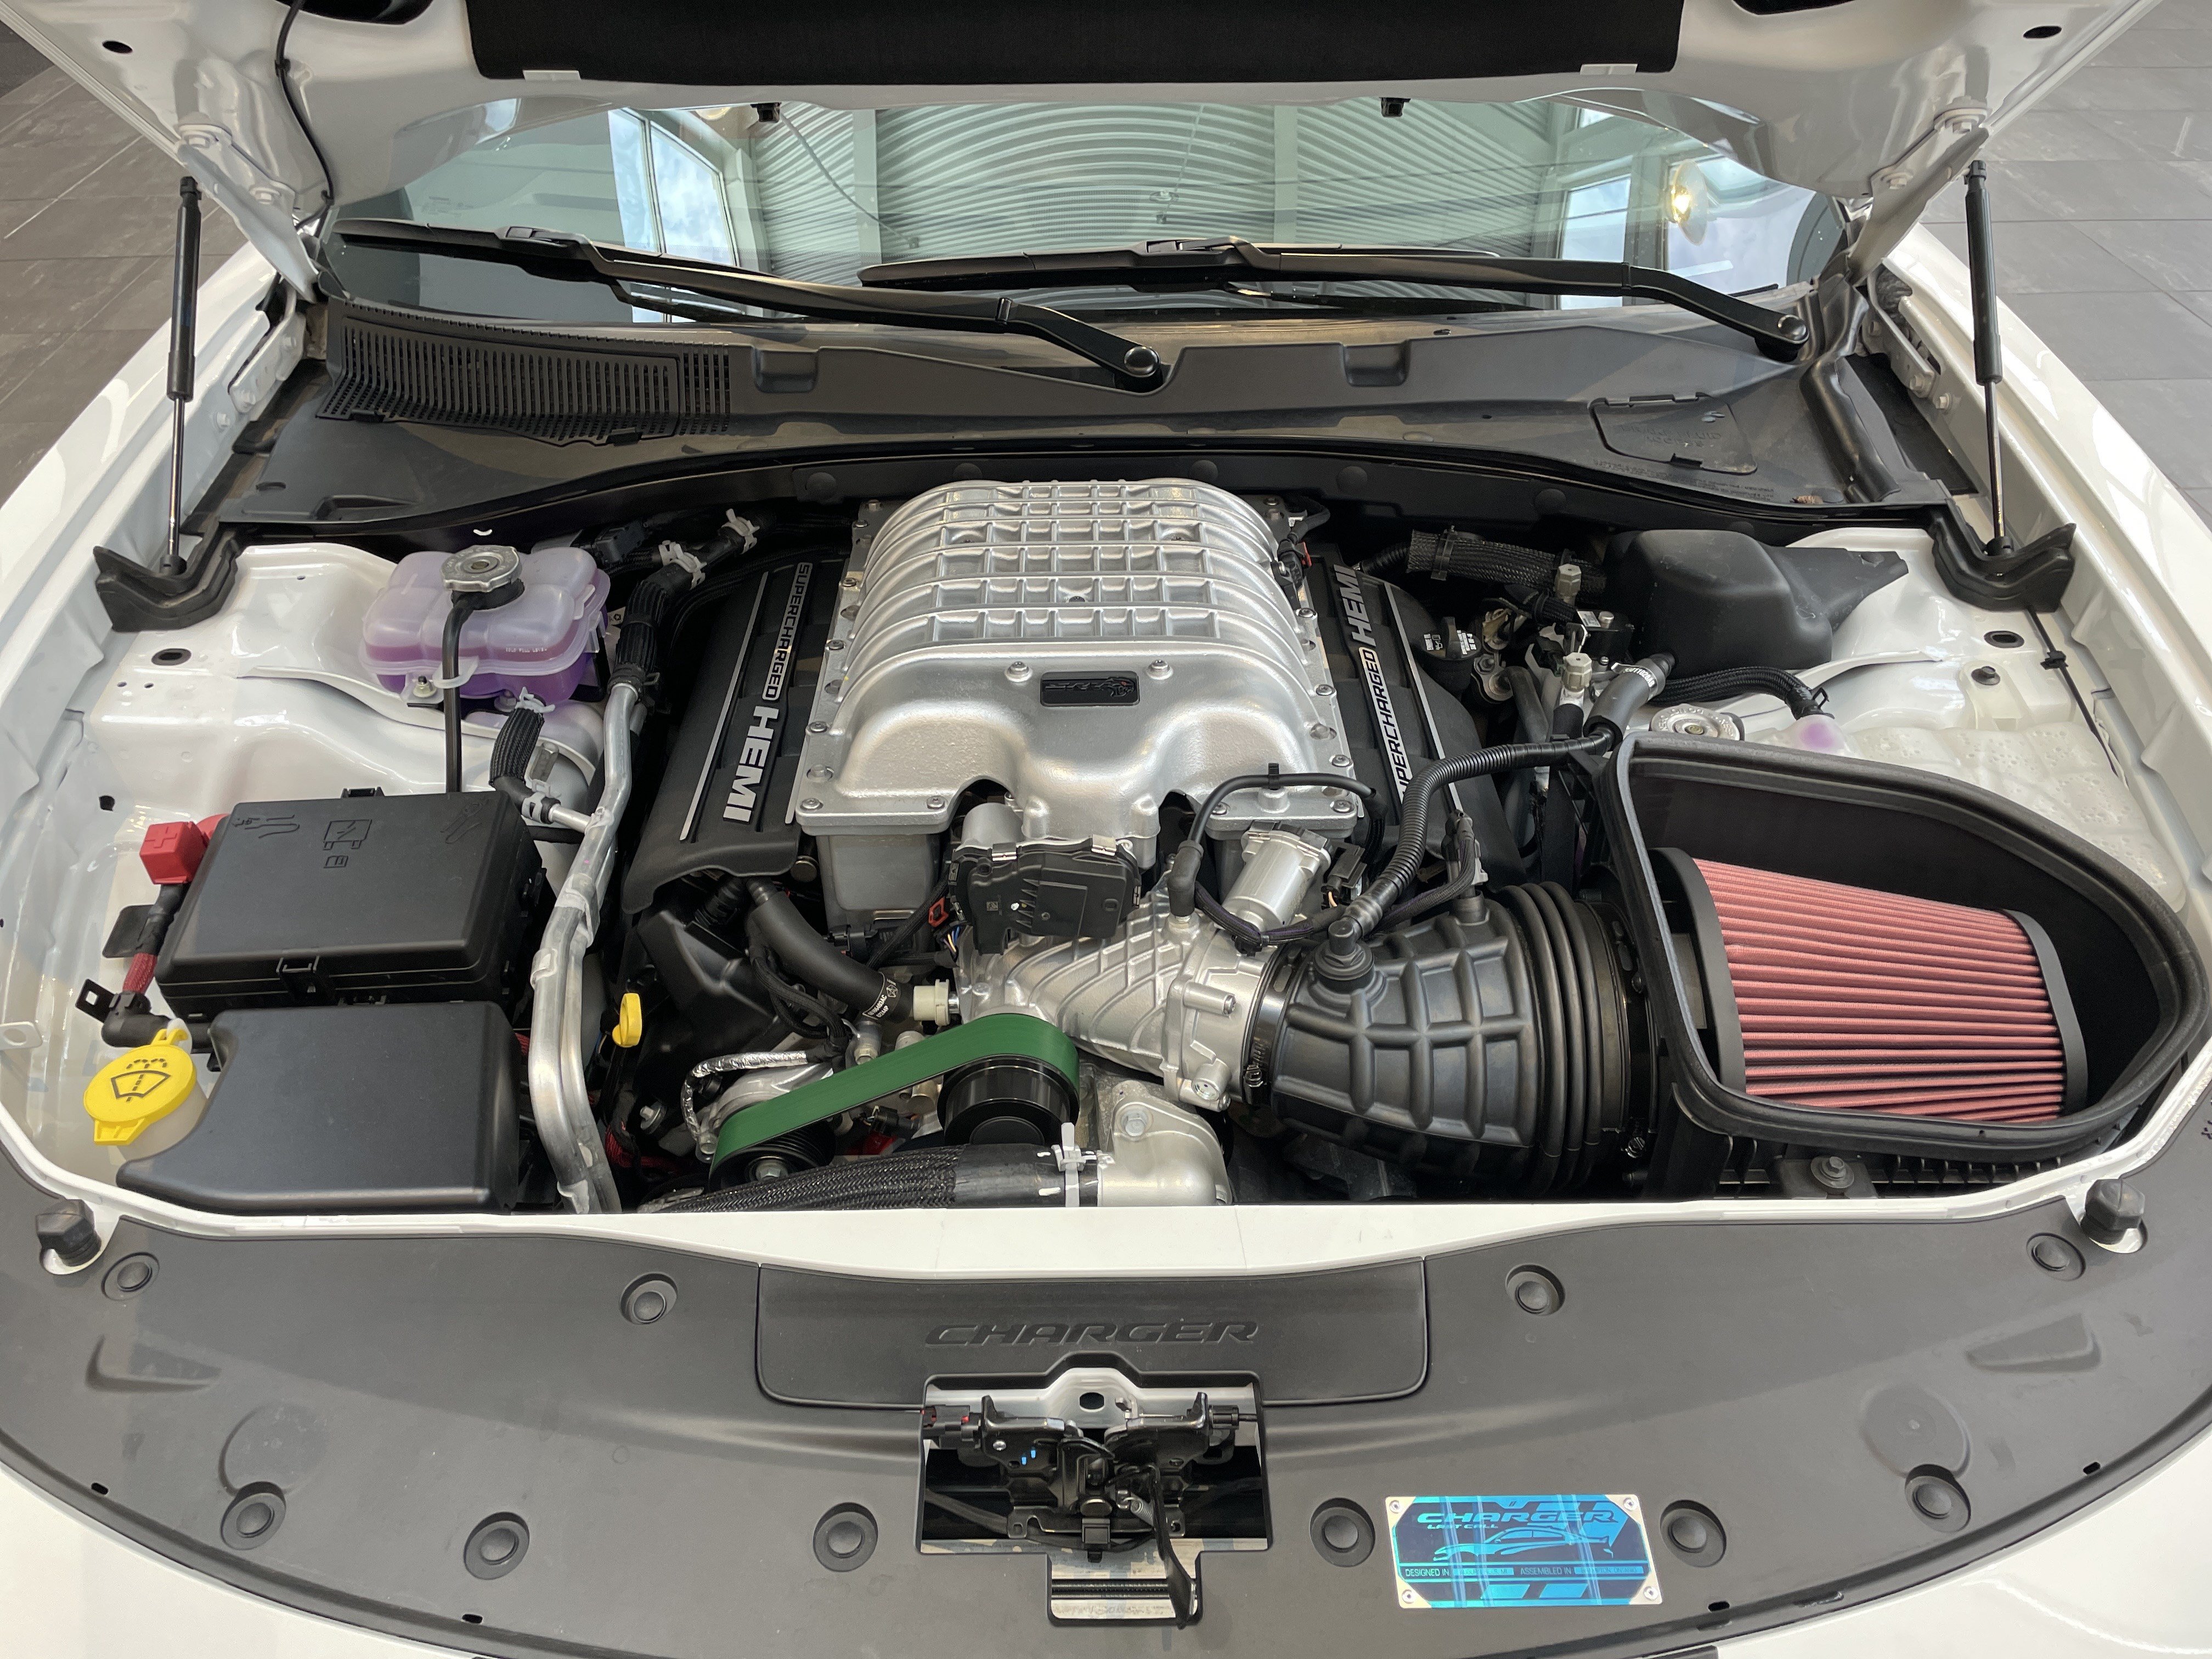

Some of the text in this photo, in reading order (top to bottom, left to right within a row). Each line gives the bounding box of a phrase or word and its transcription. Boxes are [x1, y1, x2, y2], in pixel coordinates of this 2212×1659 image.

[1333, 564, 1411, 794] PERCHARGED HEMI
[723, 563, 811, 822] SUPERCHARGED HEMI
[925, 1321, 1258, 1346] CHARGER
[1417, 1511, 1620, 1524] CHARGER
[1406, 1568, 1440, 1577] DESIGNED
[1442, 1568, 1449, 1576] IN
[1520, 1567, 1562, 1576] ASSEMBLED
[1564, 1567, 1572, 1575] IN
